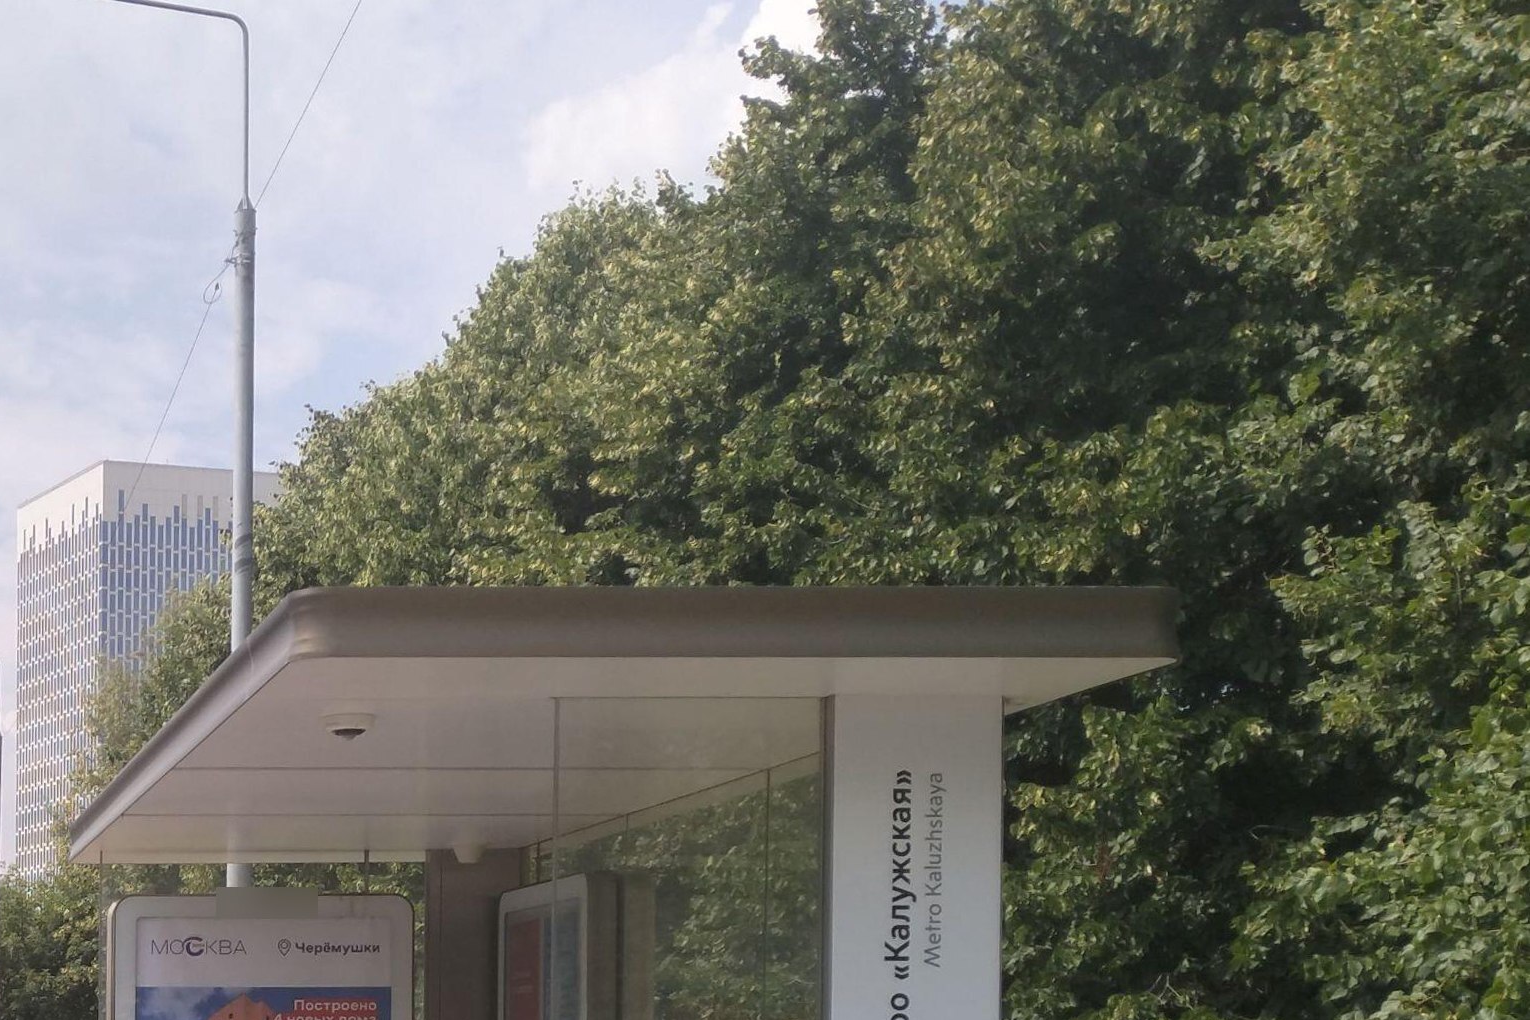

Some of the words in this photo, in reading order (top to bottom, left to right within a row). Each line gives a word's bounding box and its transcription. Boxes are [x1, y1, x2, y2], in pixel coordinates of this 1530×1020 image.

[924, 772, 947, 896] Kaluzhskaya
[883, 769, 917, 980] «Калужская»
[151, 936, 247, 957] МОСКВА
[295, 941, 381, 956] Черёмушки
[923, 902, 942, 968] Metro
[293, 999, 377, 1012] Построено
